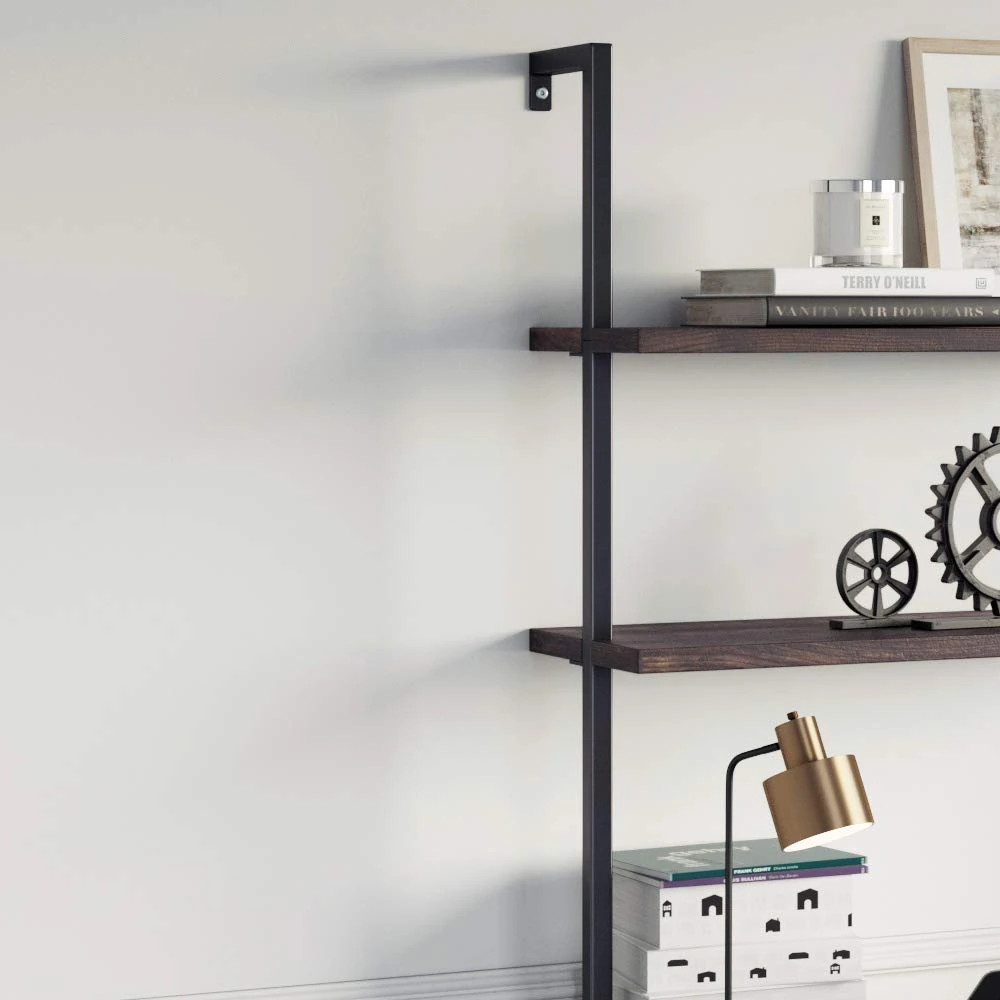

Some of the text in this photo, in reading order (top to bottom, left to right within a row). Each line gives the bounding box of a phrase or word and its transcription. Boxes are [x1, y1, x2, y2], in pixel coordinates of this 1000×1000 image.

[842, 275, 927, 289] TERRY O'NEILL
[775, 304, 984, 317] VANITY FAIR 100 YEARS
